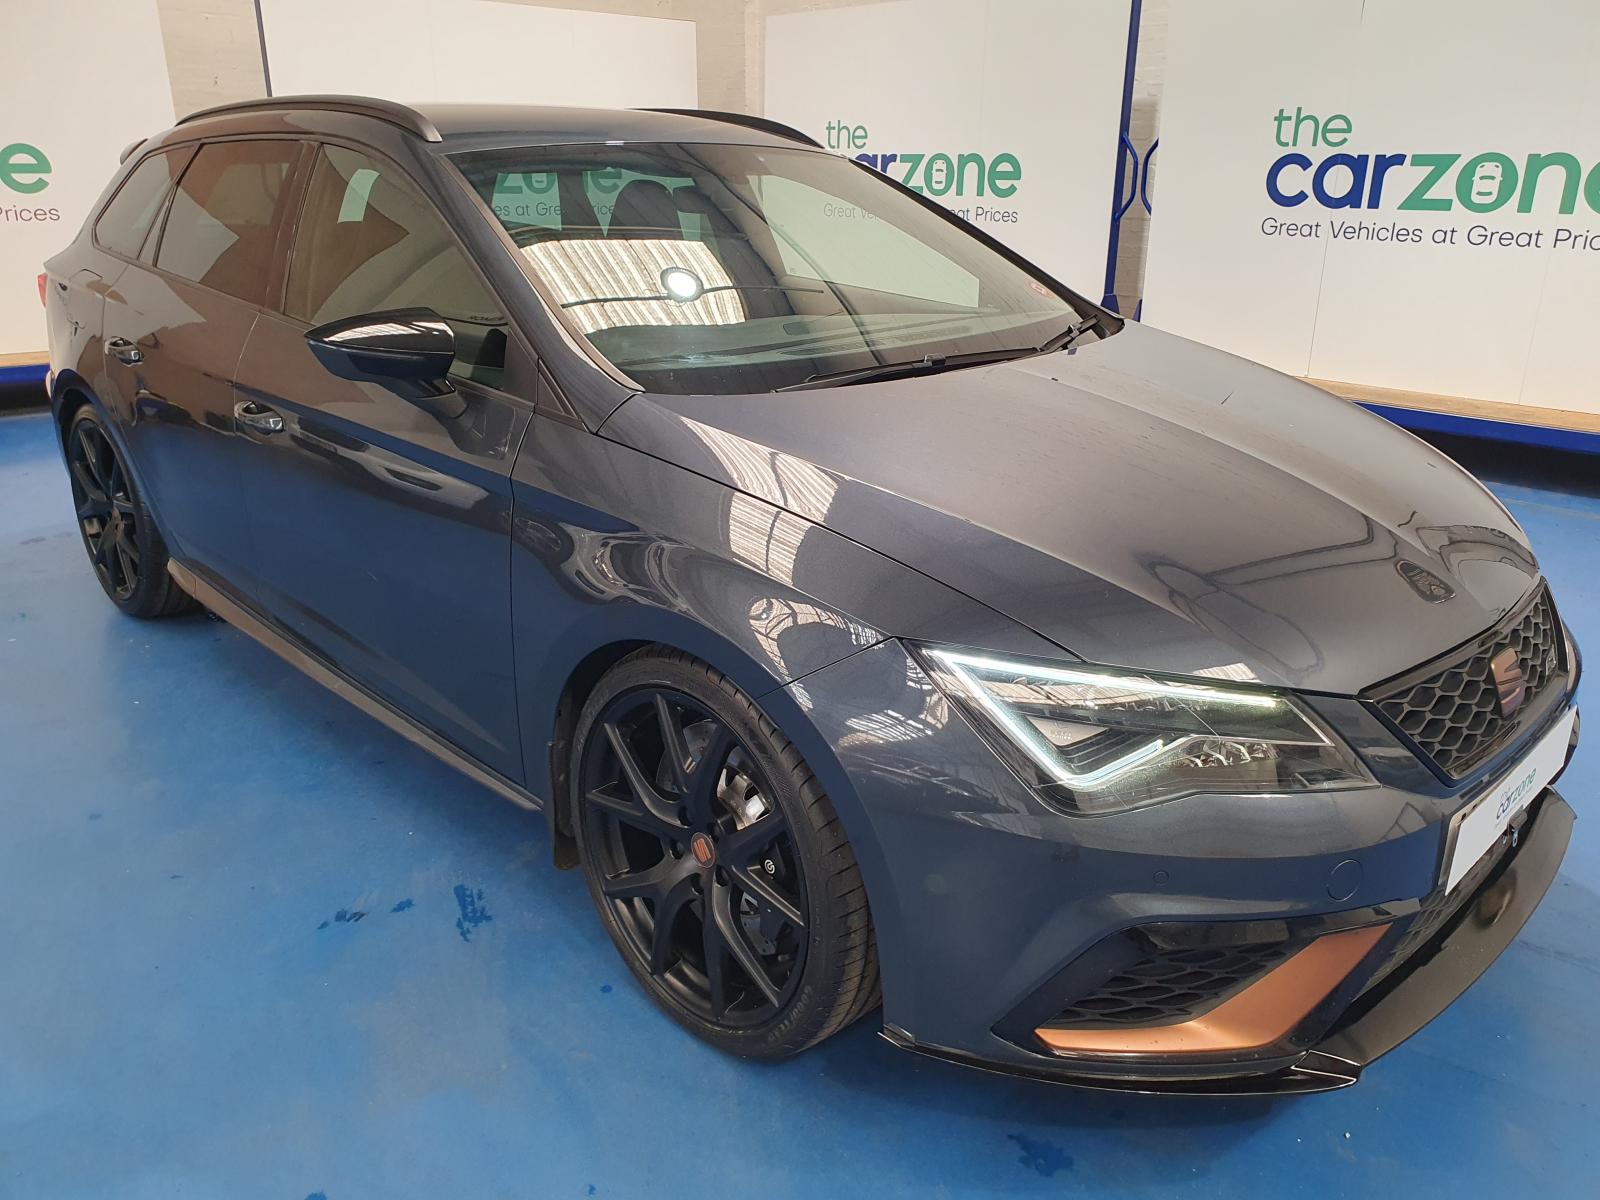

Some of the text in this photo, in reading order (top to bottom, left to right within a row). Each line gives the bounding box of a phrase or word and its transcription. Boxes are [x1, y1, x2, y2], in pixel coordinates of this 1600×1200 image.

[826, 120, 868, 149] the
[1273, 107, 1353, 147] the
[855, 153, 1021, 198] rzone
[1266, 152, 1600, 214] carzon
[0, 205, 60, 221] rices
[535, 202, 563, 216] Gre
[976, 206, 1018, 223] Prices
[1261, 216, 1322, 239] Great
[1330, 220, 1423, 244] Vehicles
[1431, 226, 1459, 246] at
[1467, 224, 1544, 249] Great
